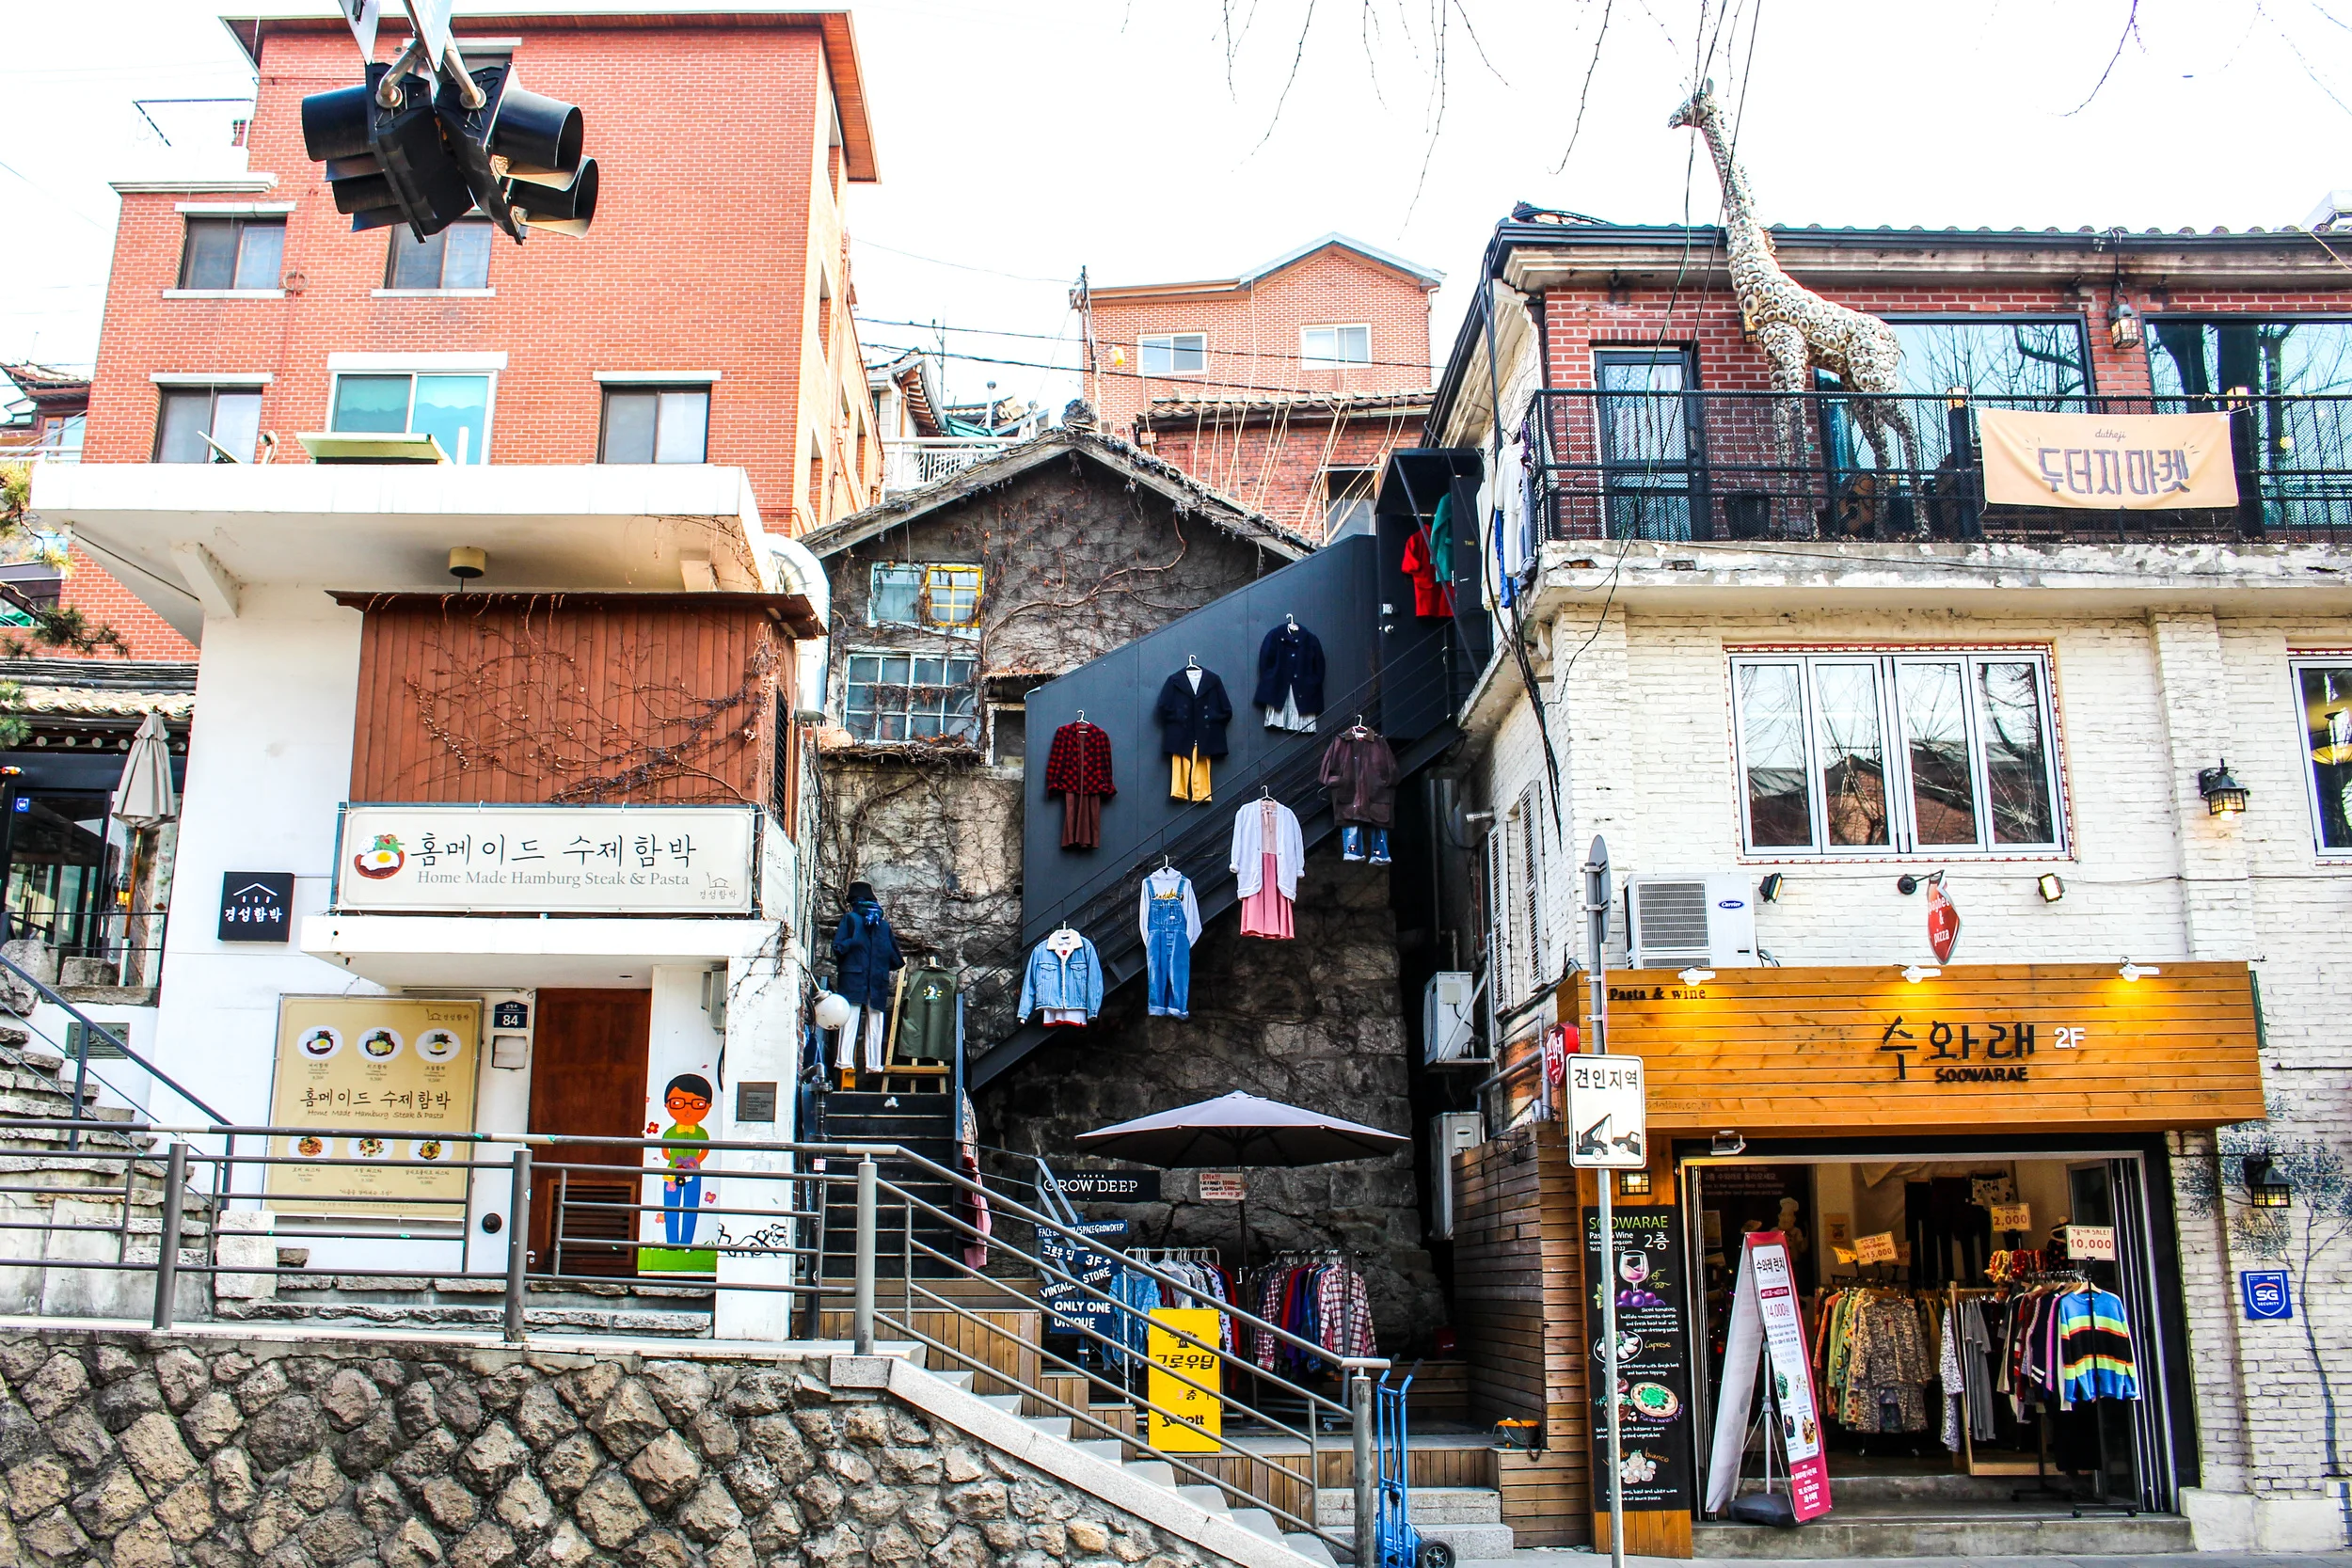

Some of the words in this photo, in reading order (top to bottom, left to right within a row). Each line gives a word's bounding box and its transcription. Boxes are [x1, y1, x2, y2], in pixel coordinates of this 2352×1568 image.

[2095, 429, 2126, 442] dutheji
[410, 832, 546, 866] 홈메이드
[563, 833, 697, 868] 수제함박
[418, 870, 461, 884] Home
[466, 871, 507, 884] Made
[509, 871, 580, 888] Hamburg
[584, 871, 625, 885] Steak
[629, 873, 645, 885] &
[649, 873, 690, 886] Pasta
[1721, 899, 1742, 909] Carrier
[225, 906, 283, 924] 경성함박
[1939, 910, 1945, 926] &
[1933, 928, 1950, 947] pizza
[1609, 987, 1646, 1000] Pasta
[1653, 987, 1665, 1000] &
[1671, 986, 1707, 1000] wine
[502, 1014, 518, 1026] 84
[1876, 1015, 2036, 1081] 수와래
[2054, 1026, 2086, 1049] 2F
[1574, 1068, 1638, 1090] 견인지역
[1934, 1067, 2029, 1083] SOOWARAE
[300, 1087, 371, 1108] 홈메이드
[380, 1090, 451, 1111] 수제함박
[355, 1111, 389, 1120] Hamburg
[1043, 1179, 1093, 1192] GROW
[1096, 1180, 1137, 1193] DEEP
[1994, 1214, 2027, 1227] 2,000
[1644, 1231, 1670, 1251] 2층
[2070, 1238, 2112, 1249] 10,000
[1085, 1255, 1103, 1267] 3F
[1867, 1247, 1892, 1259] 15,000
[1756, 1258, 1773, 1274] 수와래
[1773, 1257, 1787, 1272] 런치
[1040, 1281, 1076, 1298] VINTAG
[1082, 1267, 1112, 1284] STORE
[2256, 1290, 2279, 1301] SG
[1054, 1300, 1085, 1312] ONLY
[1087, 1301, 1111, 1313] ONE
[1644, 1339, 1671, 1352] Caprese
[1155, 1354, 1216, 1370] 그로우딥
[1645, 1447, 1669, 1463] bianco
